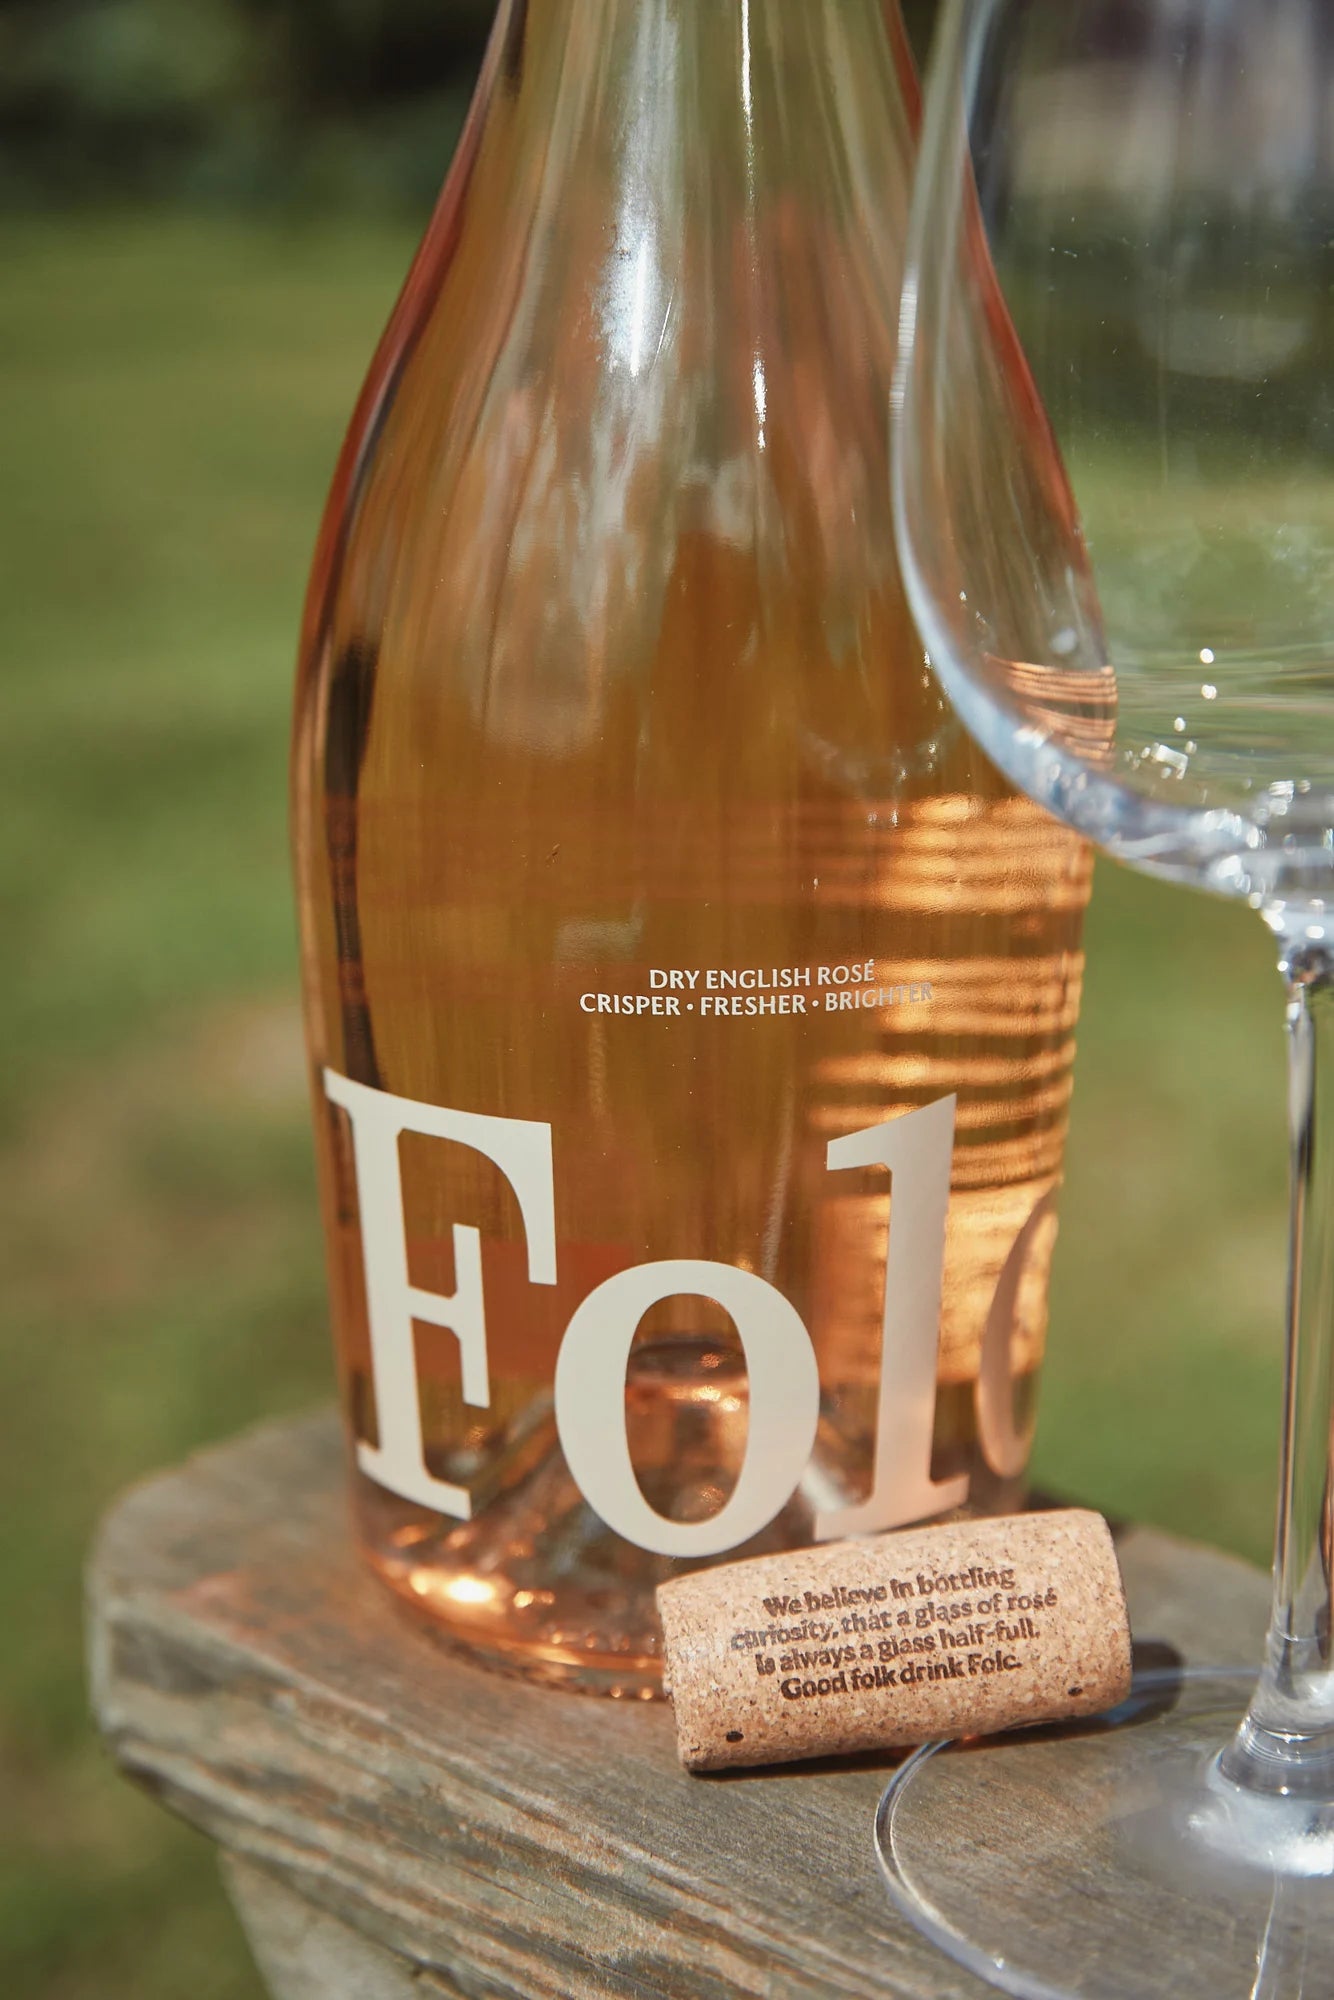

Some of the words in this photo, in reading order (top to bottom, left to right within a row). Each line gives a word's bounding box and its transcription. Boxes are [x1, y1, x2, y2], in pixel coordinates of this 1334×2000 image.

[649, 969, 700, 989] DRY
[706, 967, 811, 990] ENGLISH
[817, 959, 875, 986] ROSÉ
[579, 993, 681, 1016] CRISPER
[700, 994, 807, 1016] FRESHER
[825, 982, 933, 1012] BRIGHTER
[763, 1595, 802, 1617] We
[803, 1586, 887, 1613] believe
[916, 1566, 1015, 1595] bottling
[731, 1620, 839, 1650] curiosity,
[841, 1610, 892, 1634] that
[897, 1610, 911, 1626] a
[915, 1602, 972, 1628] glass
[977, 1592, 1002, 1614] of
[1007, 1587, 1058, 1611] rosé
[780, 1647, 856, 1672] always
[860, 1643, 873, 1660] a
[878, 1635, 936, 1662] glass
[781, 1671, 849, 1700] Good
[851, 1665, 897, 1691] folk
[900, 1655, 965, 1685] drink
[967, 1650, 1022, 1675] Folc.
